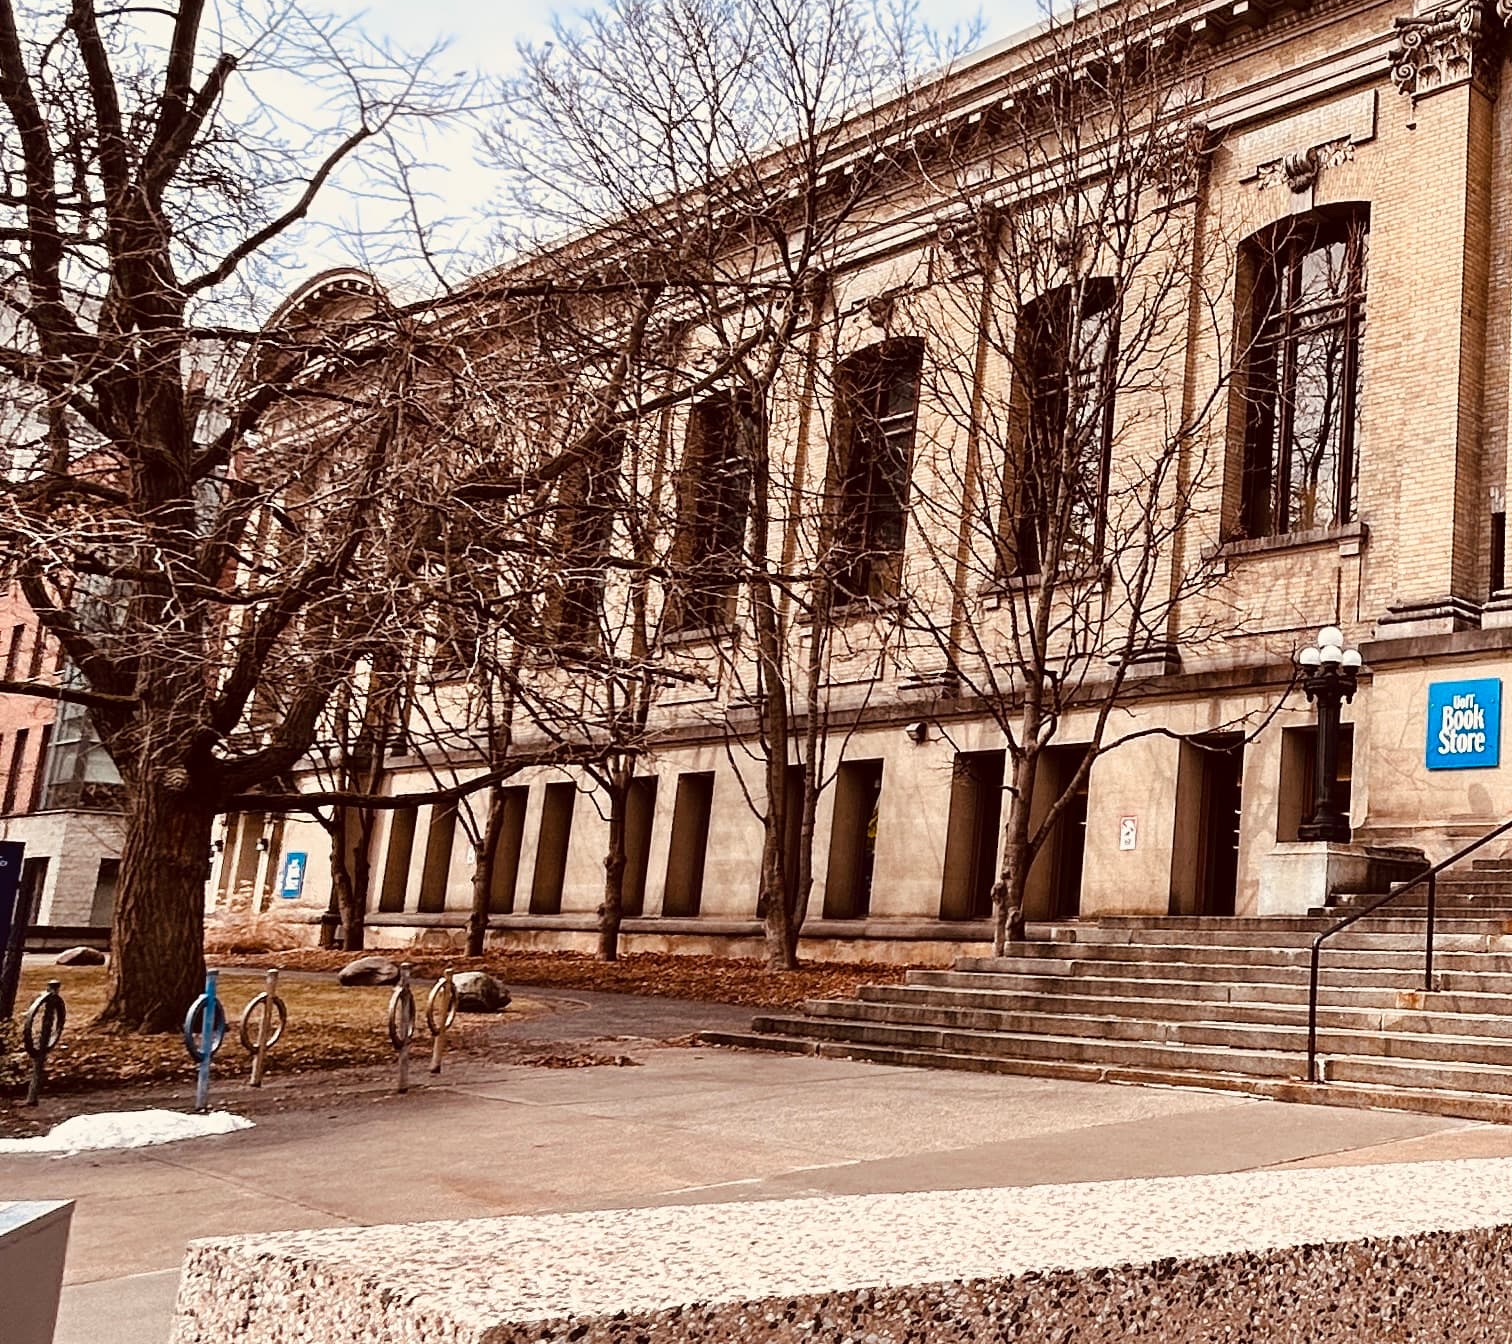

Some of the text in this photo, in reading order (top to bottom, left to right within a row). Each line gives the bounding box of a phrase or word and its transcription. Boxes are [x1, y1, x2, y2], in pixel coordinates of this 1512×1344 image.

[1453, 693, 1475, 709] UofT
[1442, 703, 1485, 731] Book
[1438, 728, 1486, 754] Store
